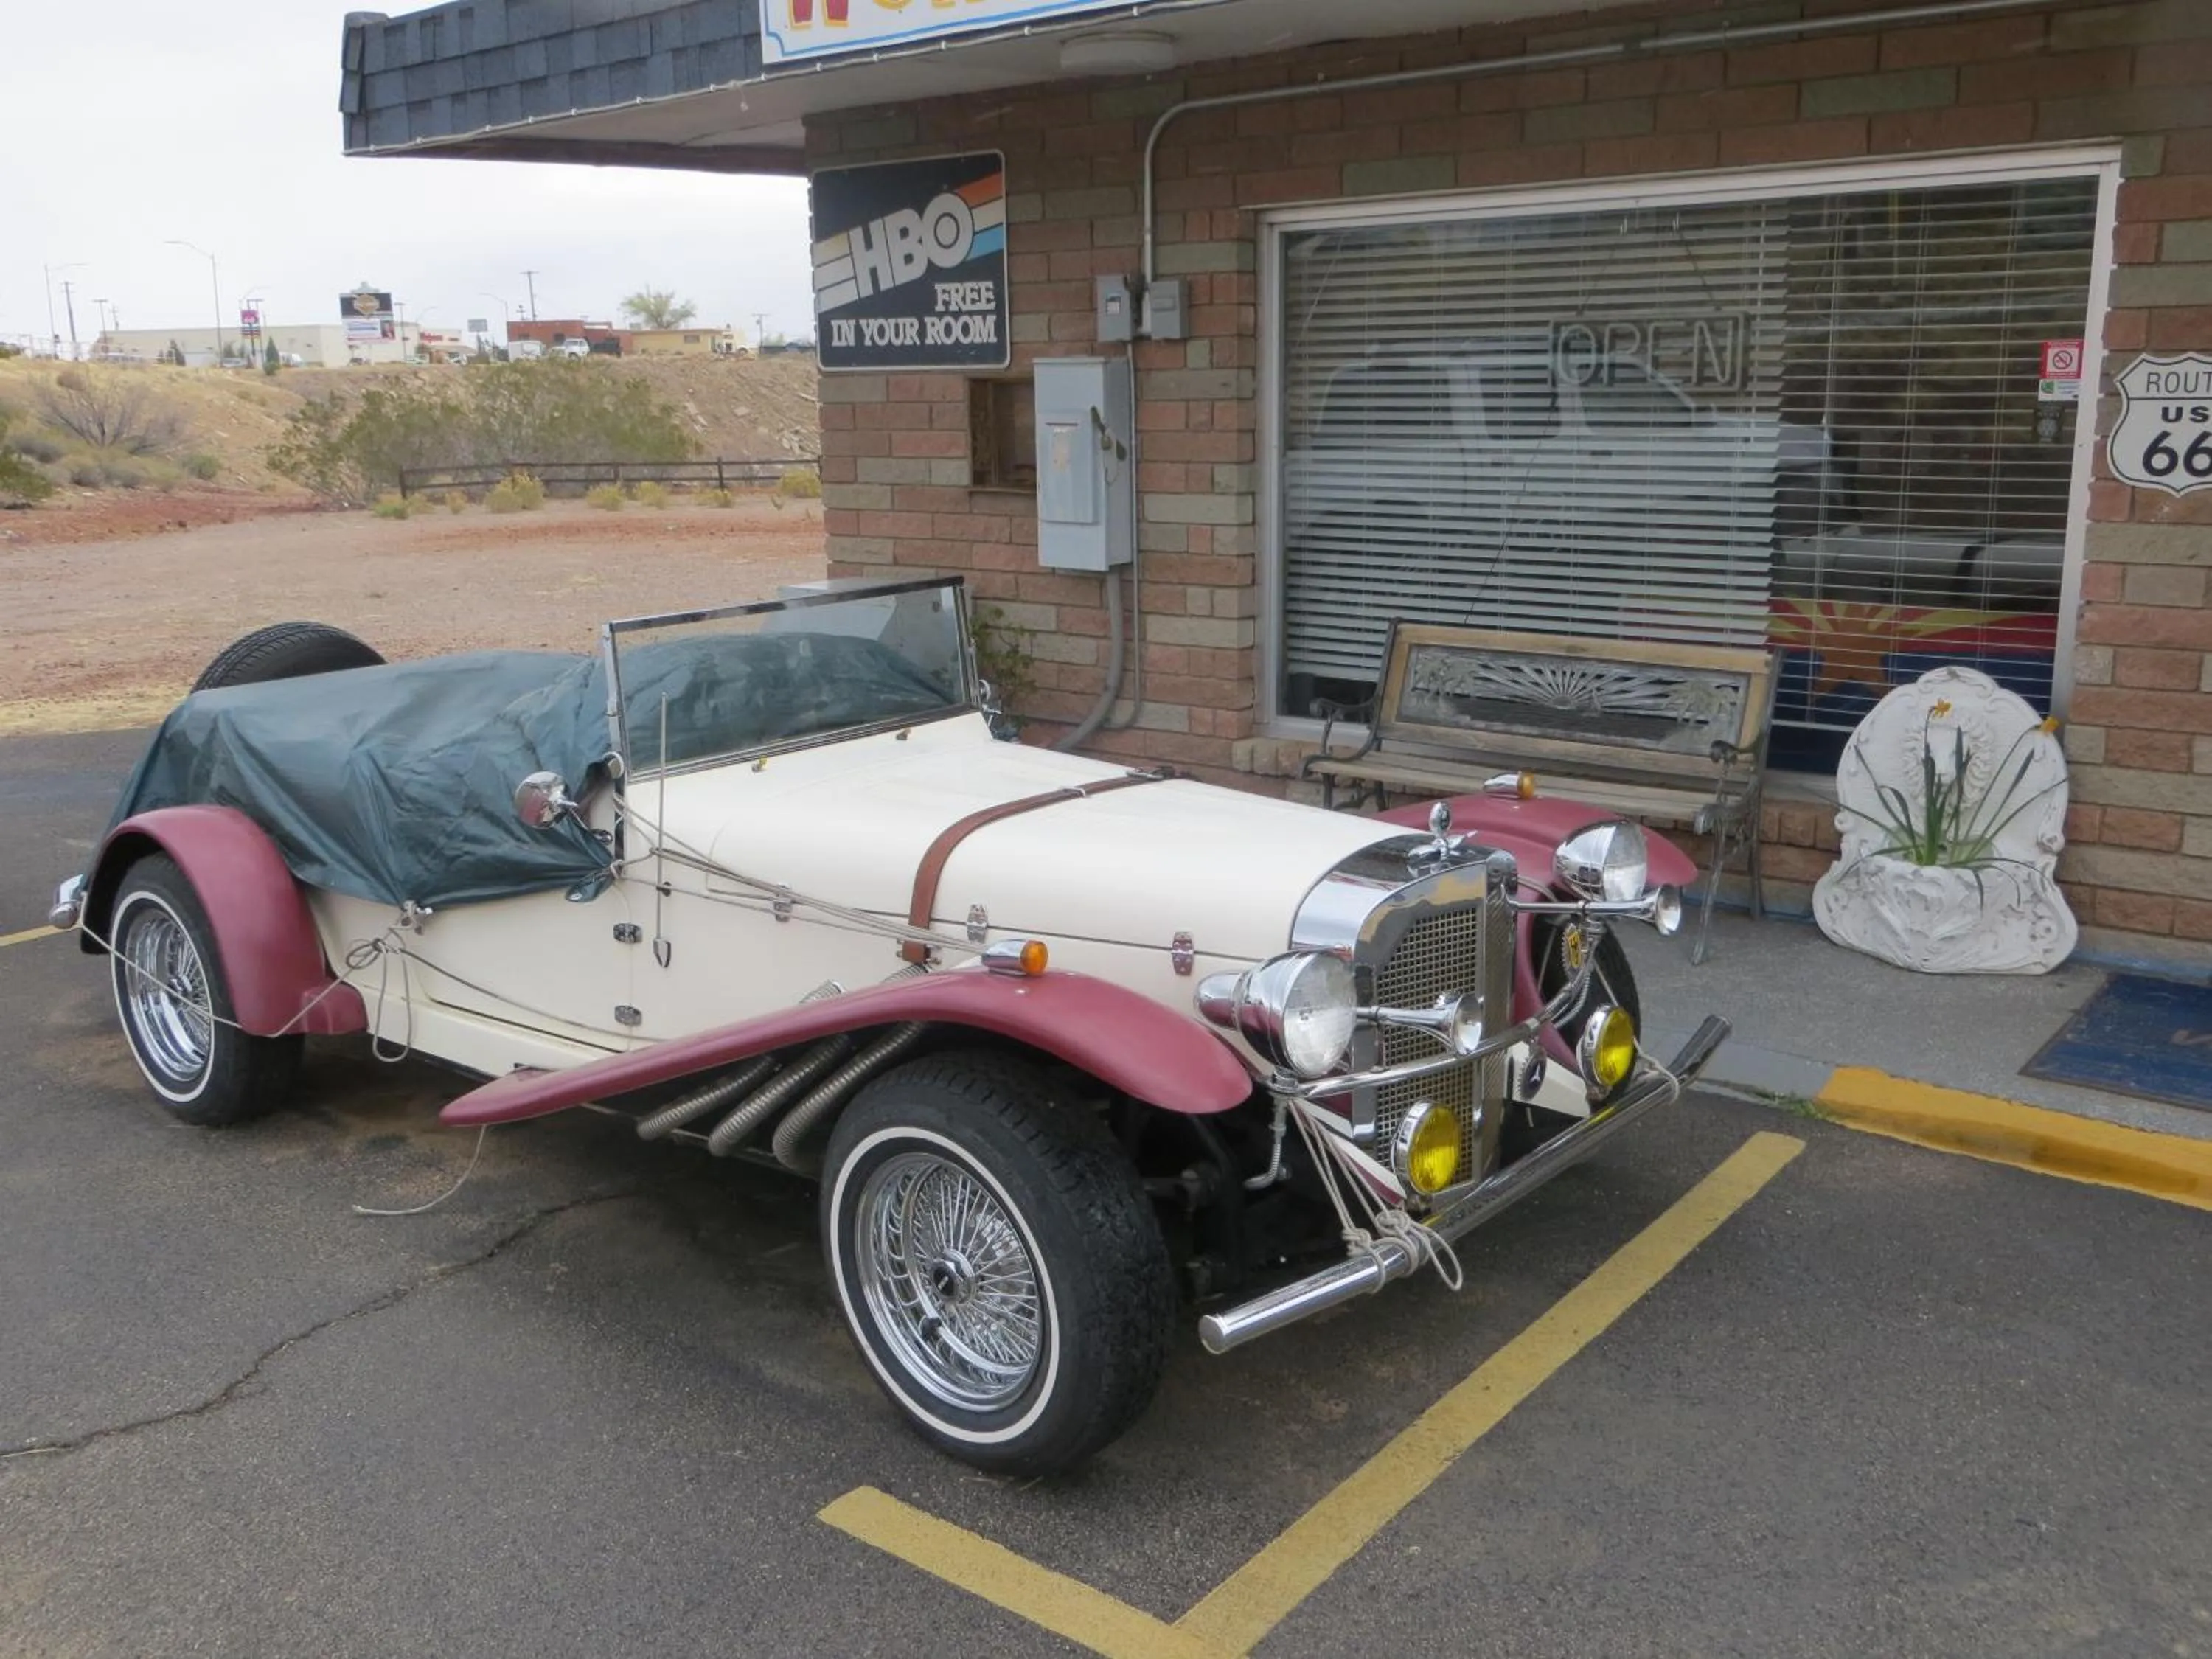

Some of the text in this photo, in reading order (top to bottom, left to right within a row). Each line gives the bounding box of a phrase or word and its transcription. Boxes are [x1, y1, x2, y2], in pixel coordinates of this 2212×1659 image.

[848, 192, 975, 299] HBO
[934, 281, 996, 312] FREE
[830, 315, 998, 347] IN YOUR ROOM
[1557, 320, 1733, 386] OPEN
[2161, 406, 2209, 424] US
[2142, 430, 2212, 478] 66
